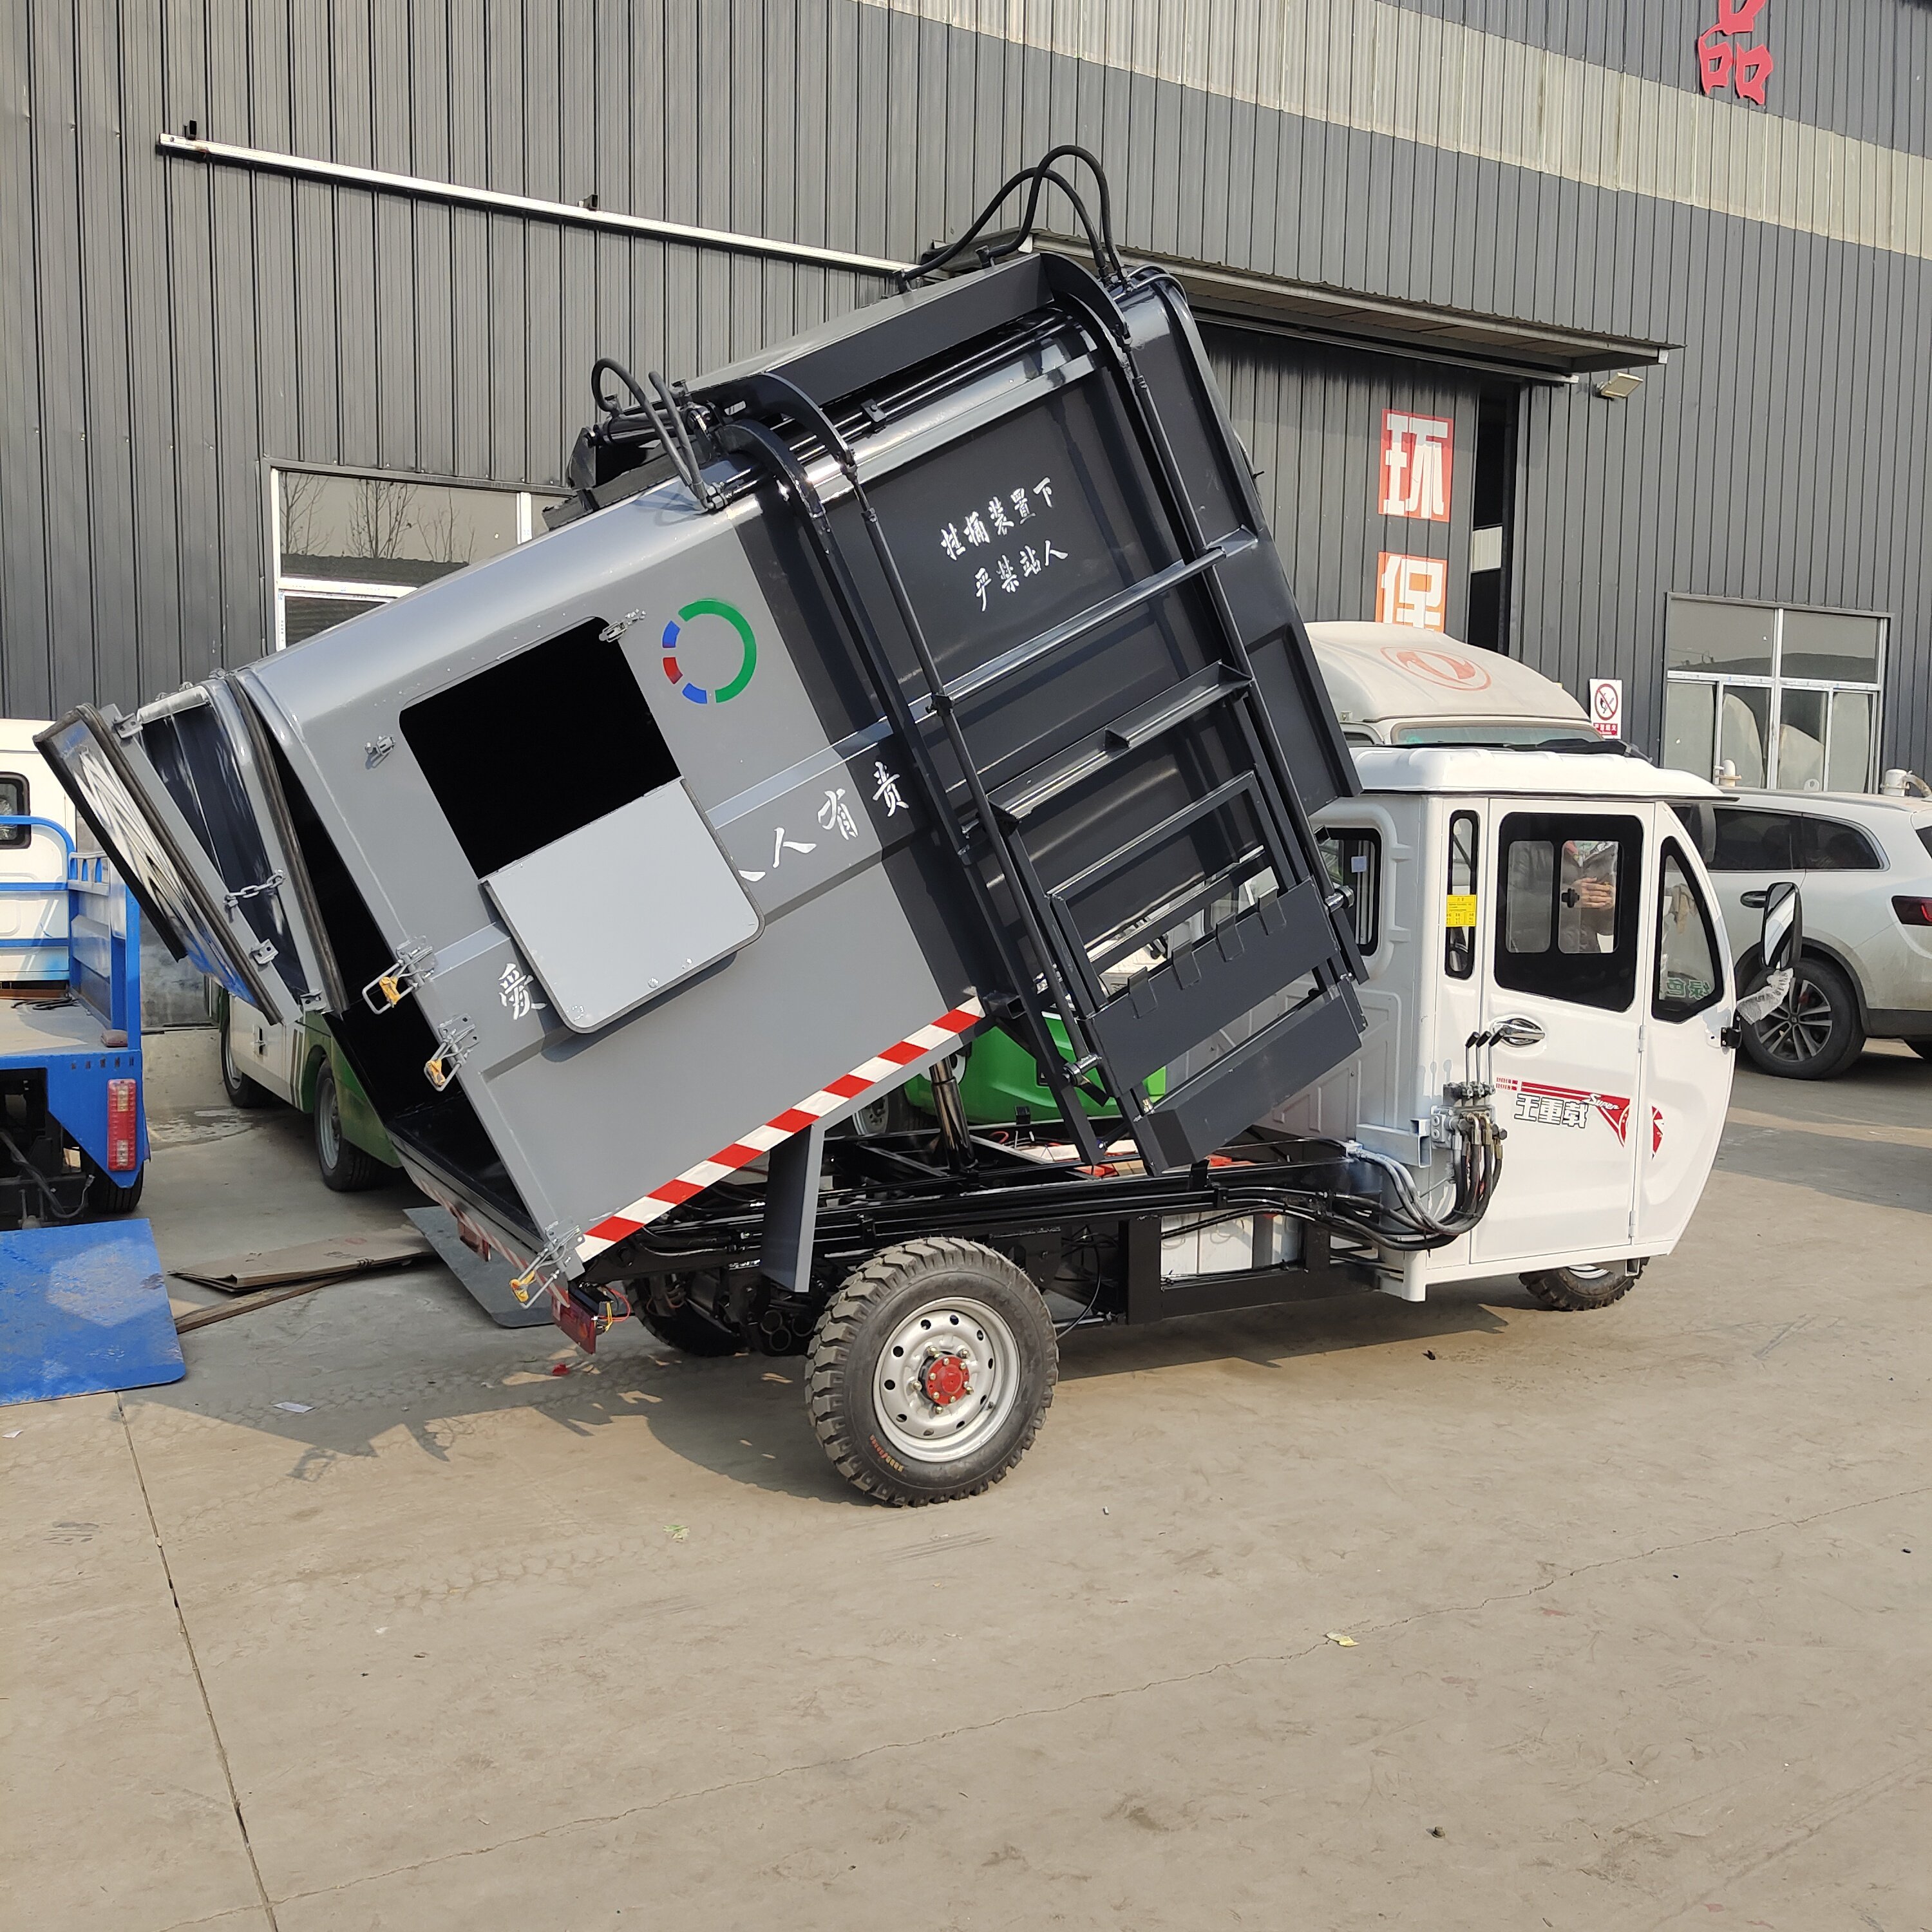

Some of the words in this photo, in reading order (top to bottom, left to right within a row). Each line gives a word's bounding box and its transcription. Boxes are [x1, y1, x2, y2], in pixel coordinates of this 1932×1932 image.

[1698, 0, 1773, 105] 品
[940, 476, 1053, 561] 挂桶装置下
[974, 539, 1069, 612] 严禁站人
